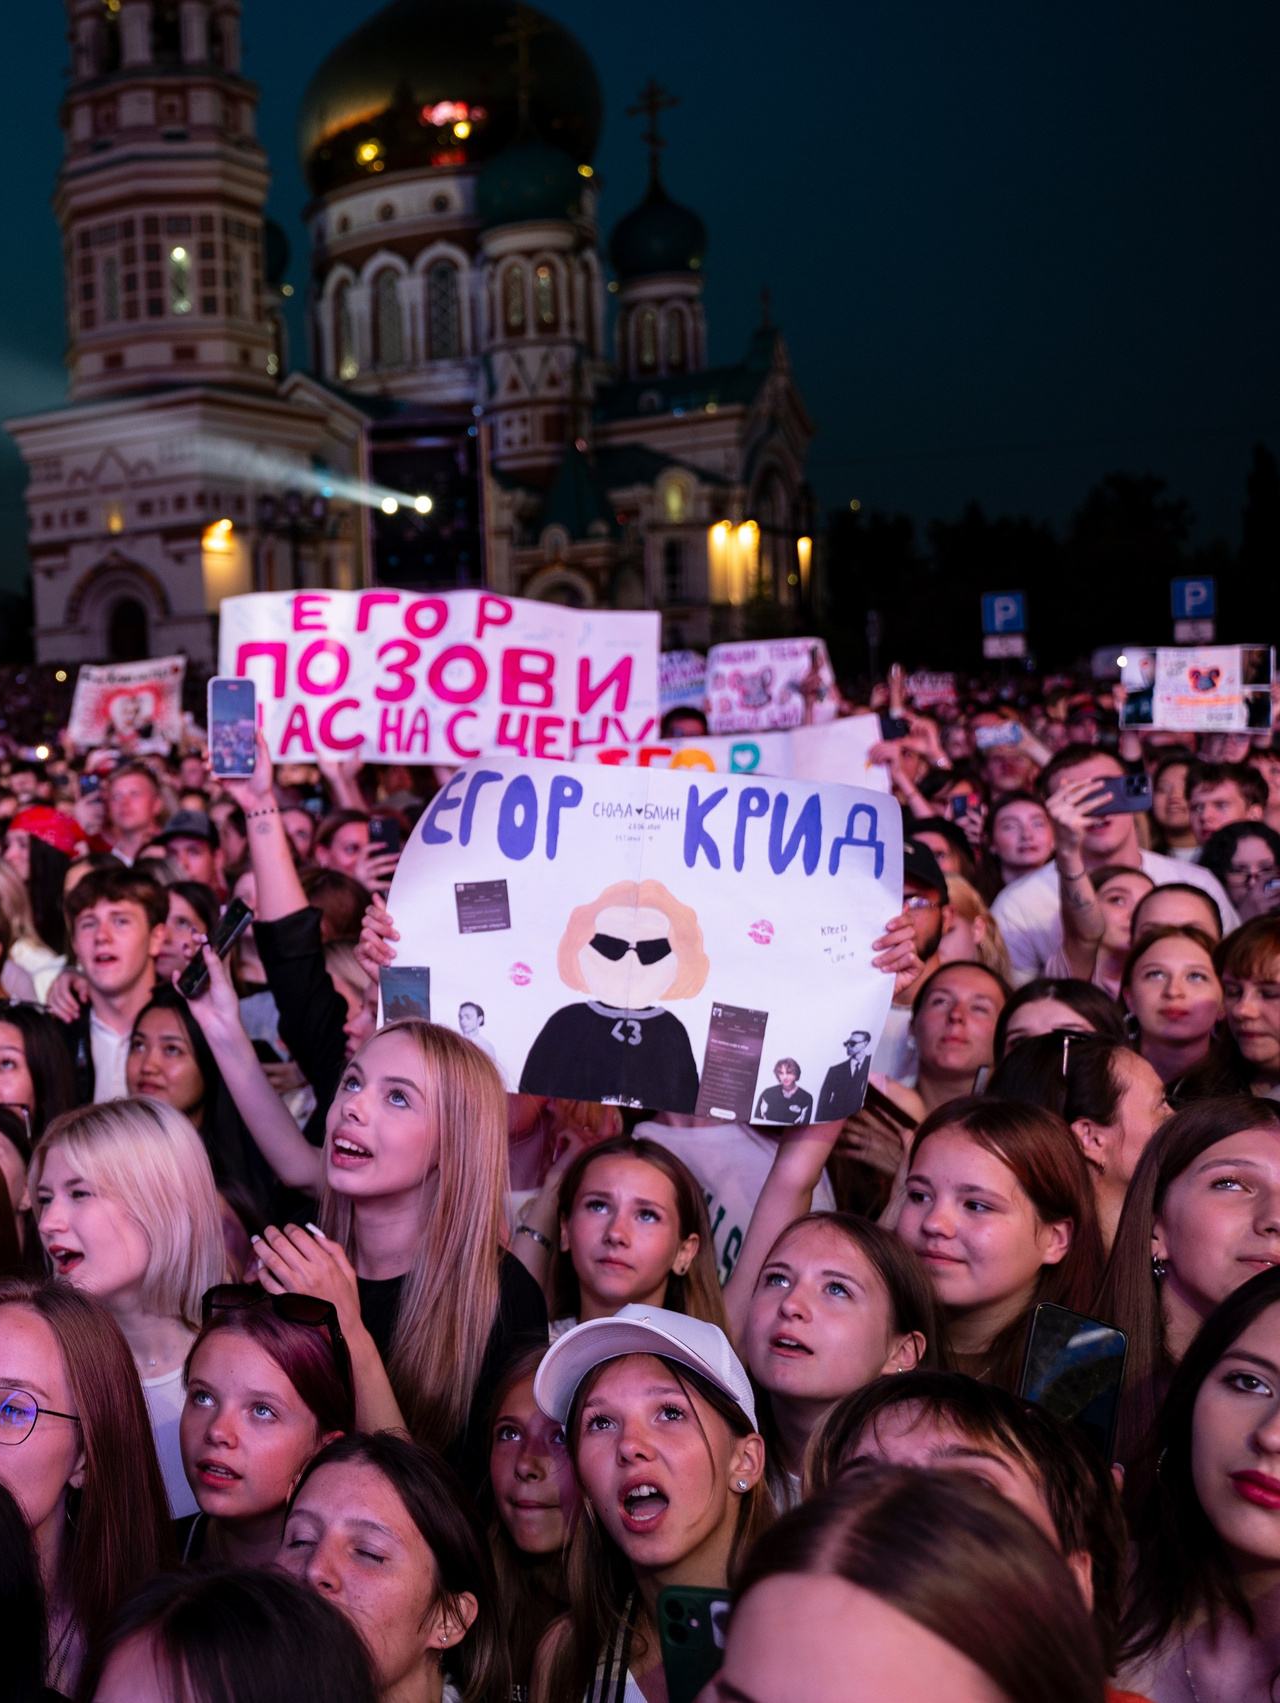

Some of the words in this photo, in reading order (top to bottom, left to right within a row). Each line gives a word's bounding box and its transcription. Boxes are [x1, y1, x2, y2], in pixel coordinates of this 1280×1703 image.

[291, 593, 513, 640] ЕГОР
[995, 596, 1018, 632] P
[1185, 581, 1208, 617] P
[236, 638, 633, 715] ПОЗОВИ
[257, 699, 365, 756] АС
[378, 706, 429, 754] НА
[421, 769, 583, 861] ЕГОР
[684, 784, 885, 880] КРИД
[592, 801, 633, 819] СЮДА
[644, 803, 680, 821] БЛИН
